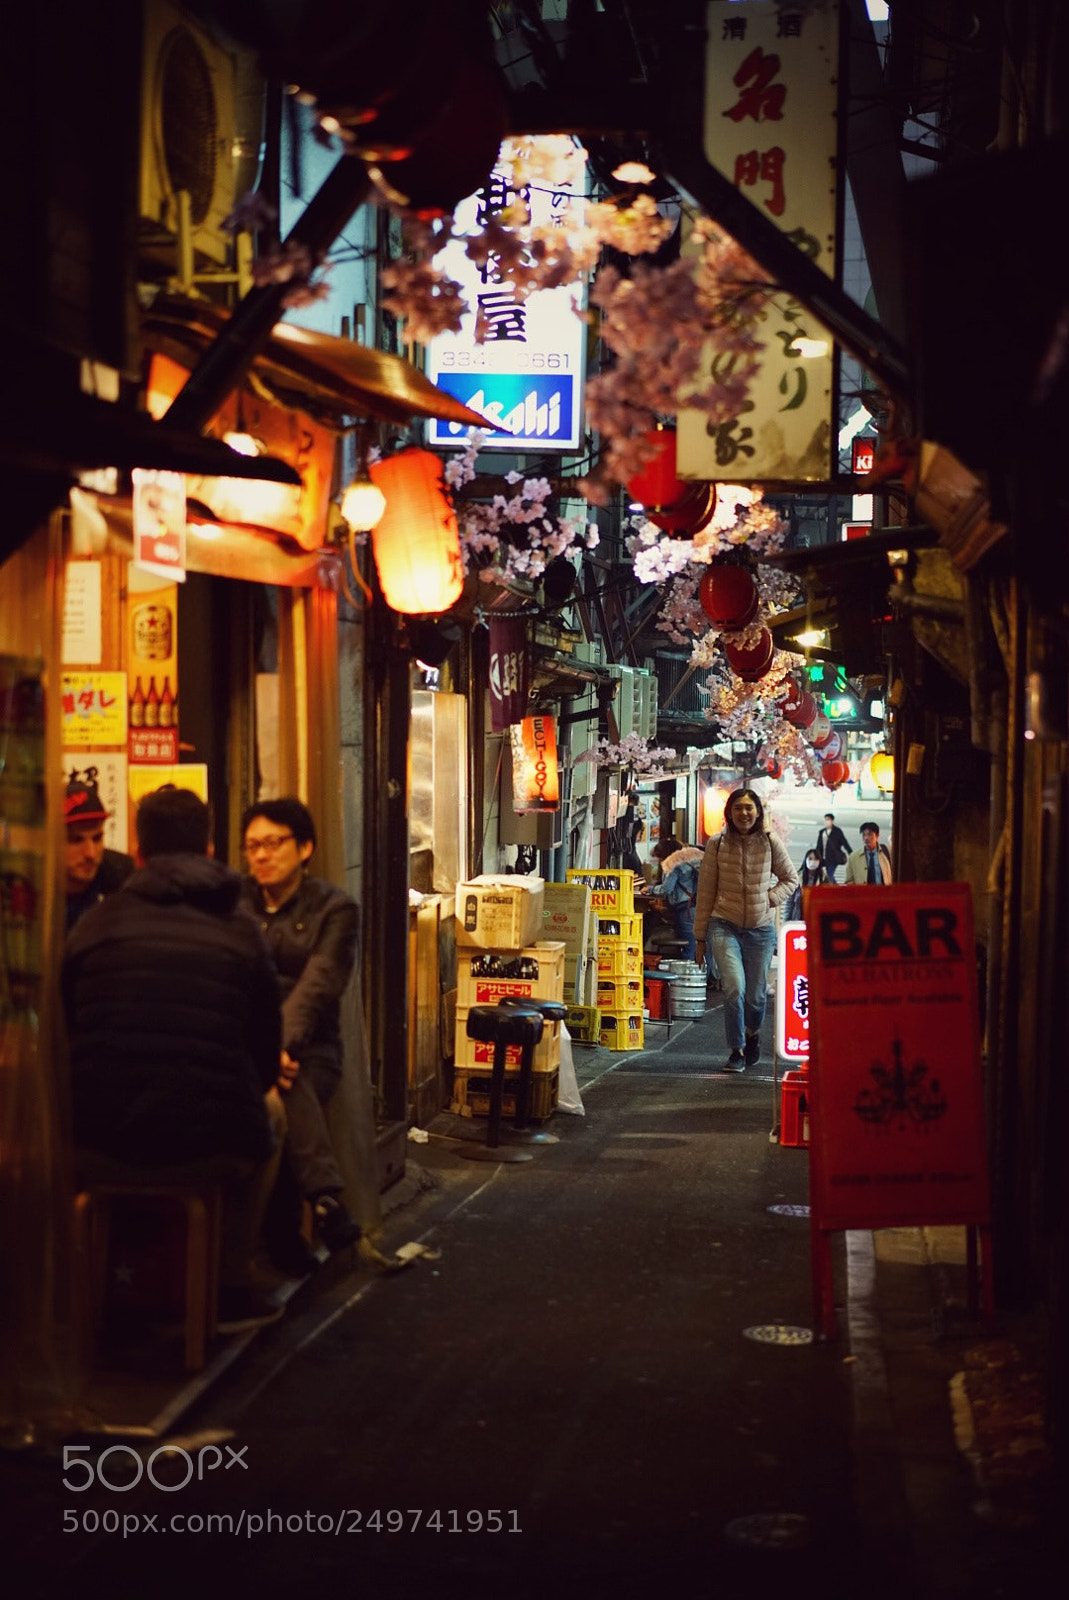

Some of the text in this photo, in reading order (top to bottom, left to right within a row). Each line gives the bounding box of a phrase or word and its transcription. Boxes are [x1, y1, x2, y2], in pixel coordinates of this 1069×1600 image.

[821, 909, 963, 960] BAR
[477, 983, 531, 995] アサヒビール
